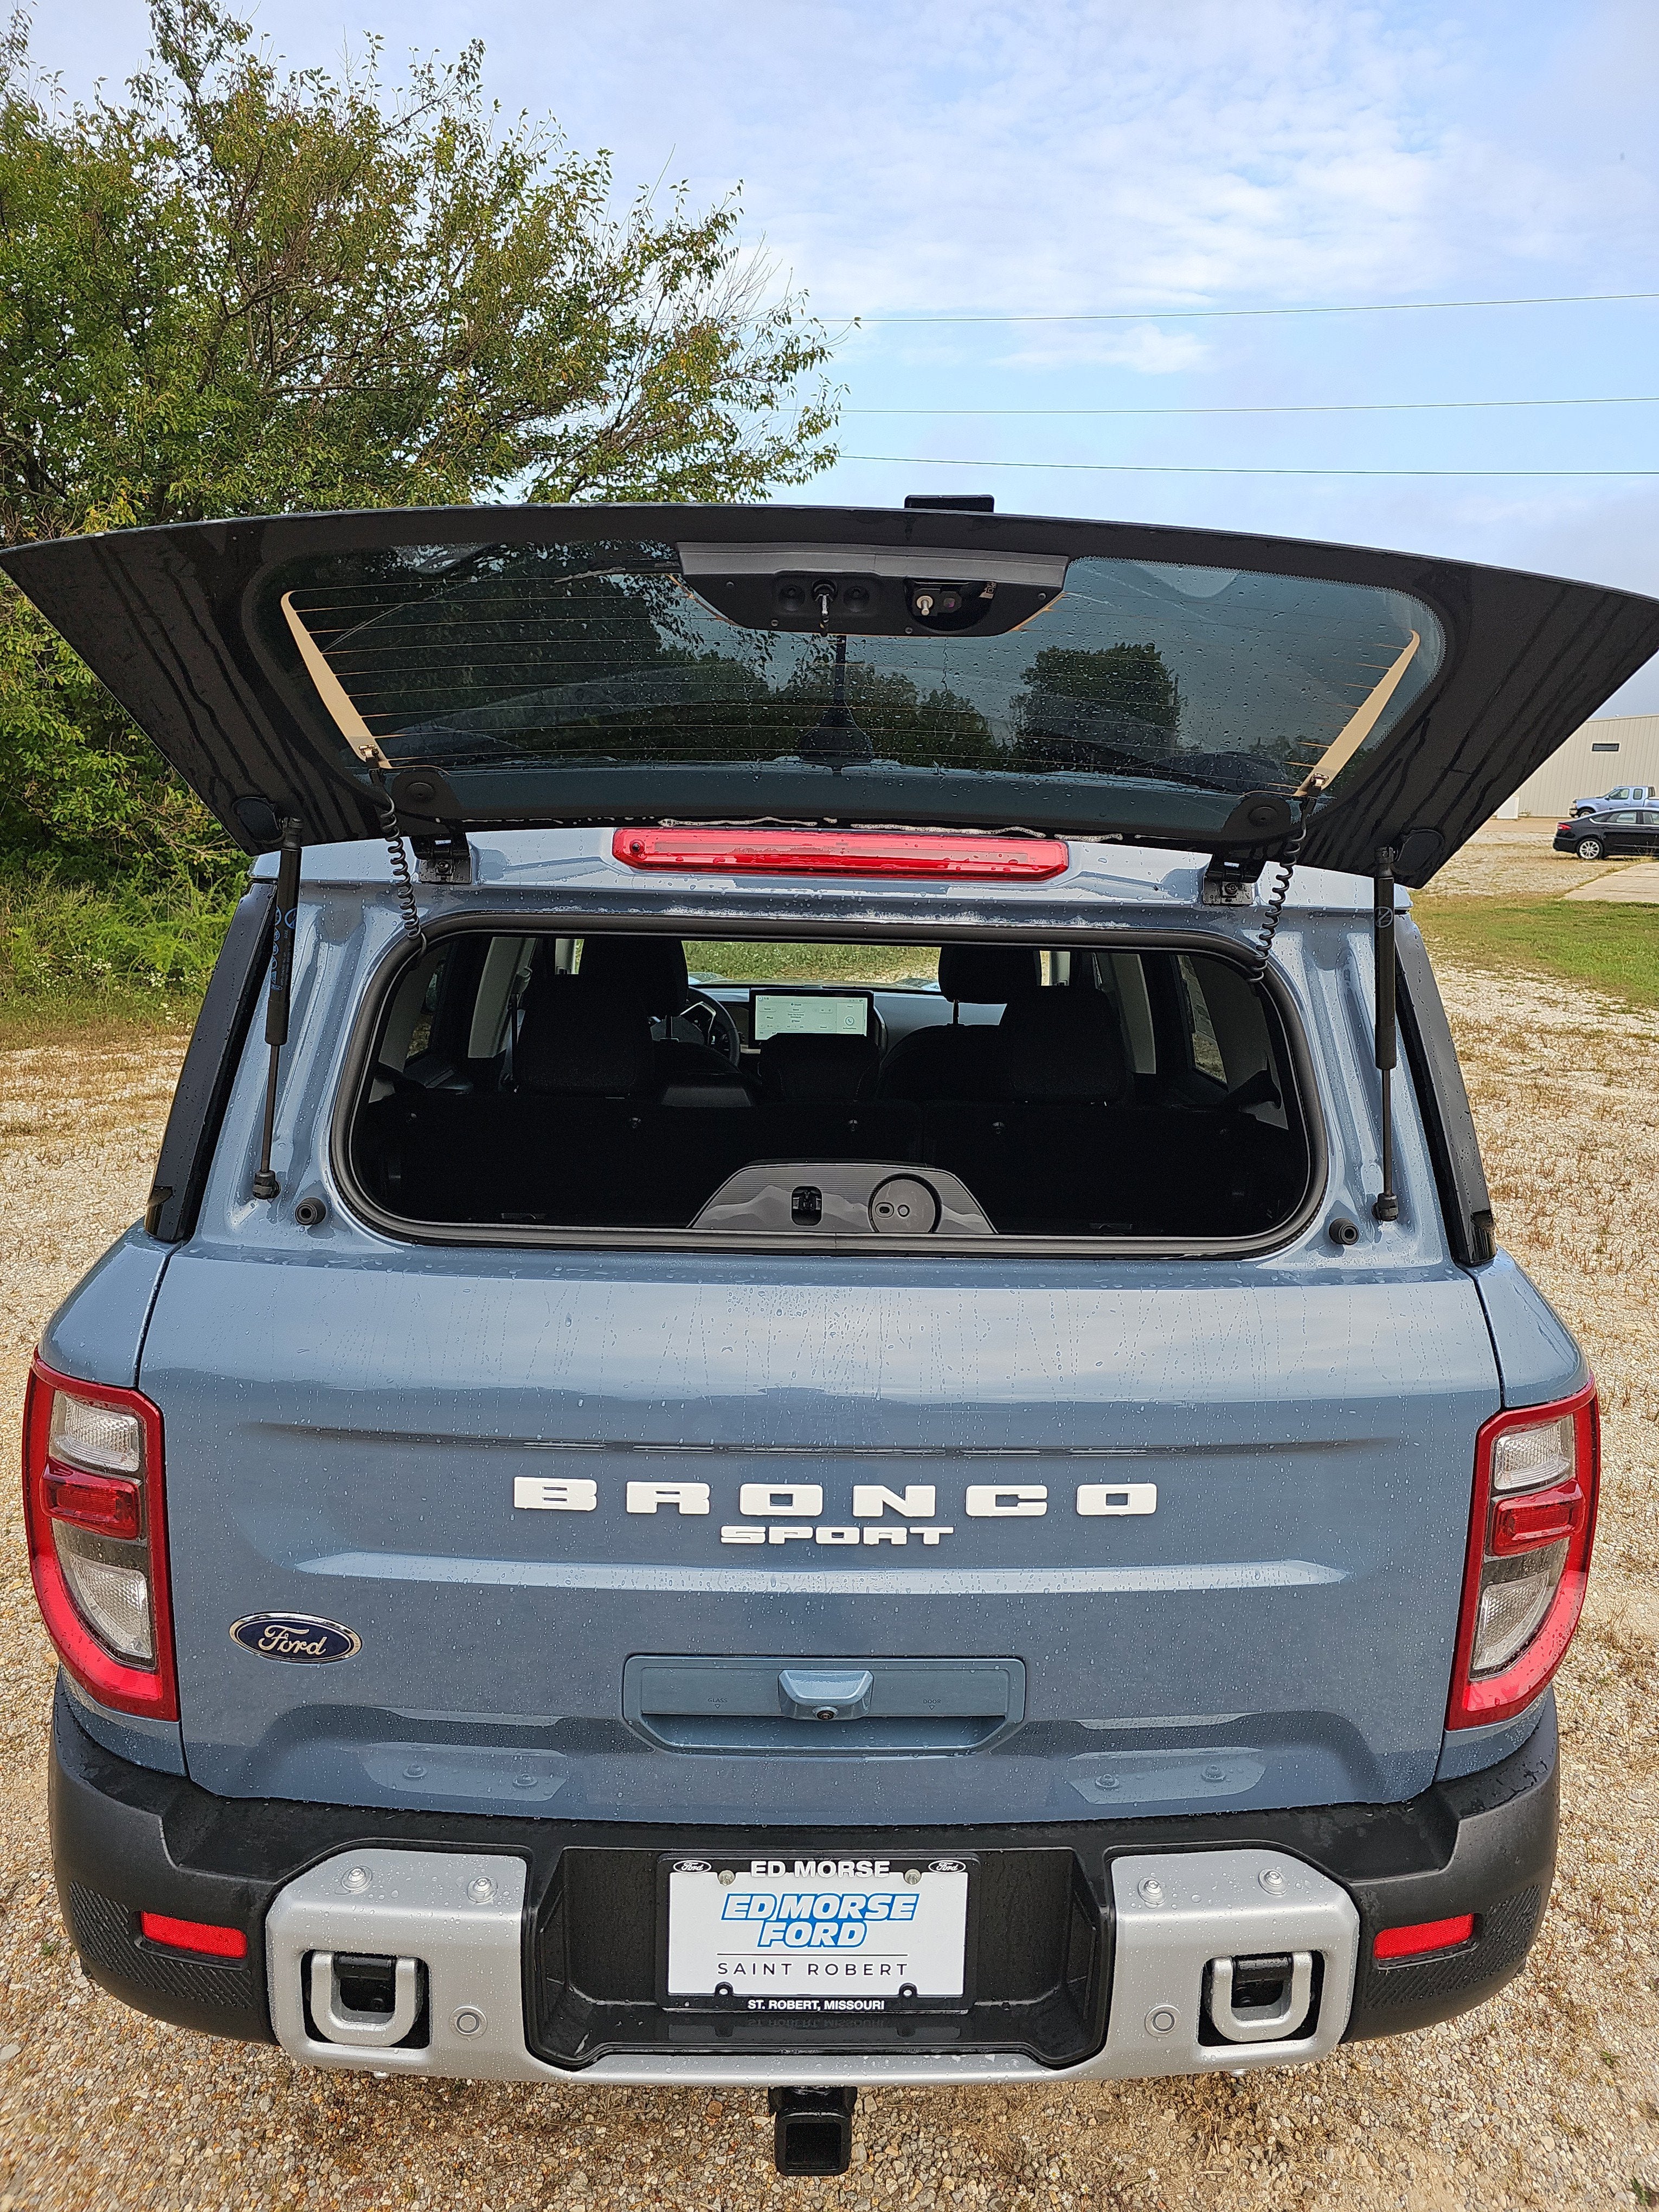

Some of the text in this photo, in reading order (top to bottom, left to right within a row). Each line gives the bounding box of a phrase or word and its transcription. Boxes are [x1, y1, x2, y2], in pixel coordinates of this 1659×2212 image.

[513, 1476, 1158, 1517] BRONCO
[721, 1526, 954, 1545] SPORT
[258, 1624, 327, 1655] Ford
[681, 1862, 704, 1871] Ford
[750, 1861, 890, 1878] ED MORSE
[936, 1862, 959, 1871] Ford
[721, 1893, 920, 1921] ED MORSE
[757, 1919, 867, 1947] FORD
[717, 1963, 908, 1976] SAINT ROBERT
[748, 2000, 885, 2011] ST. ROBERT, MISSOURI
